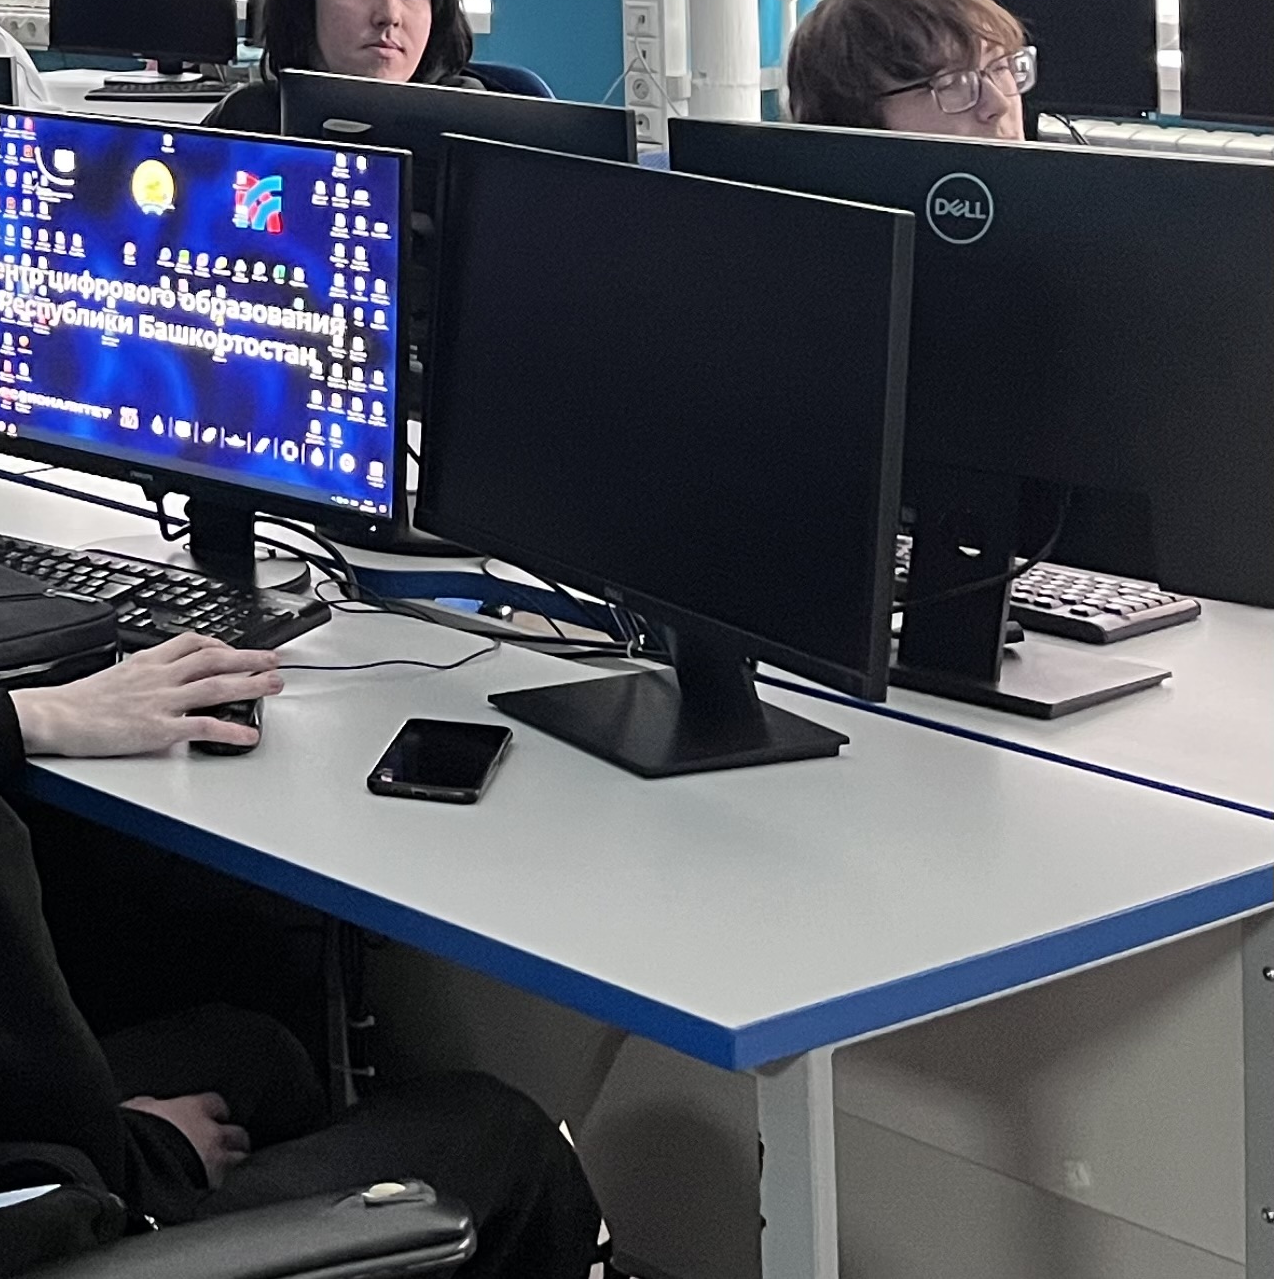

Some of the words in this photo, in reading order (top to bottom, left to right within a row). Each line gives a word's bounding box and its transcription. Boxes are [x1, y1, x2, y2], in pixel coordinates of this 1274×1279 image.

[934, 197, 987, 220] DELL
[49, 269, 176, 309] цифрового
[179, 288, 347, 337] образования
[138, 313, 319, 368] Башкортостан
